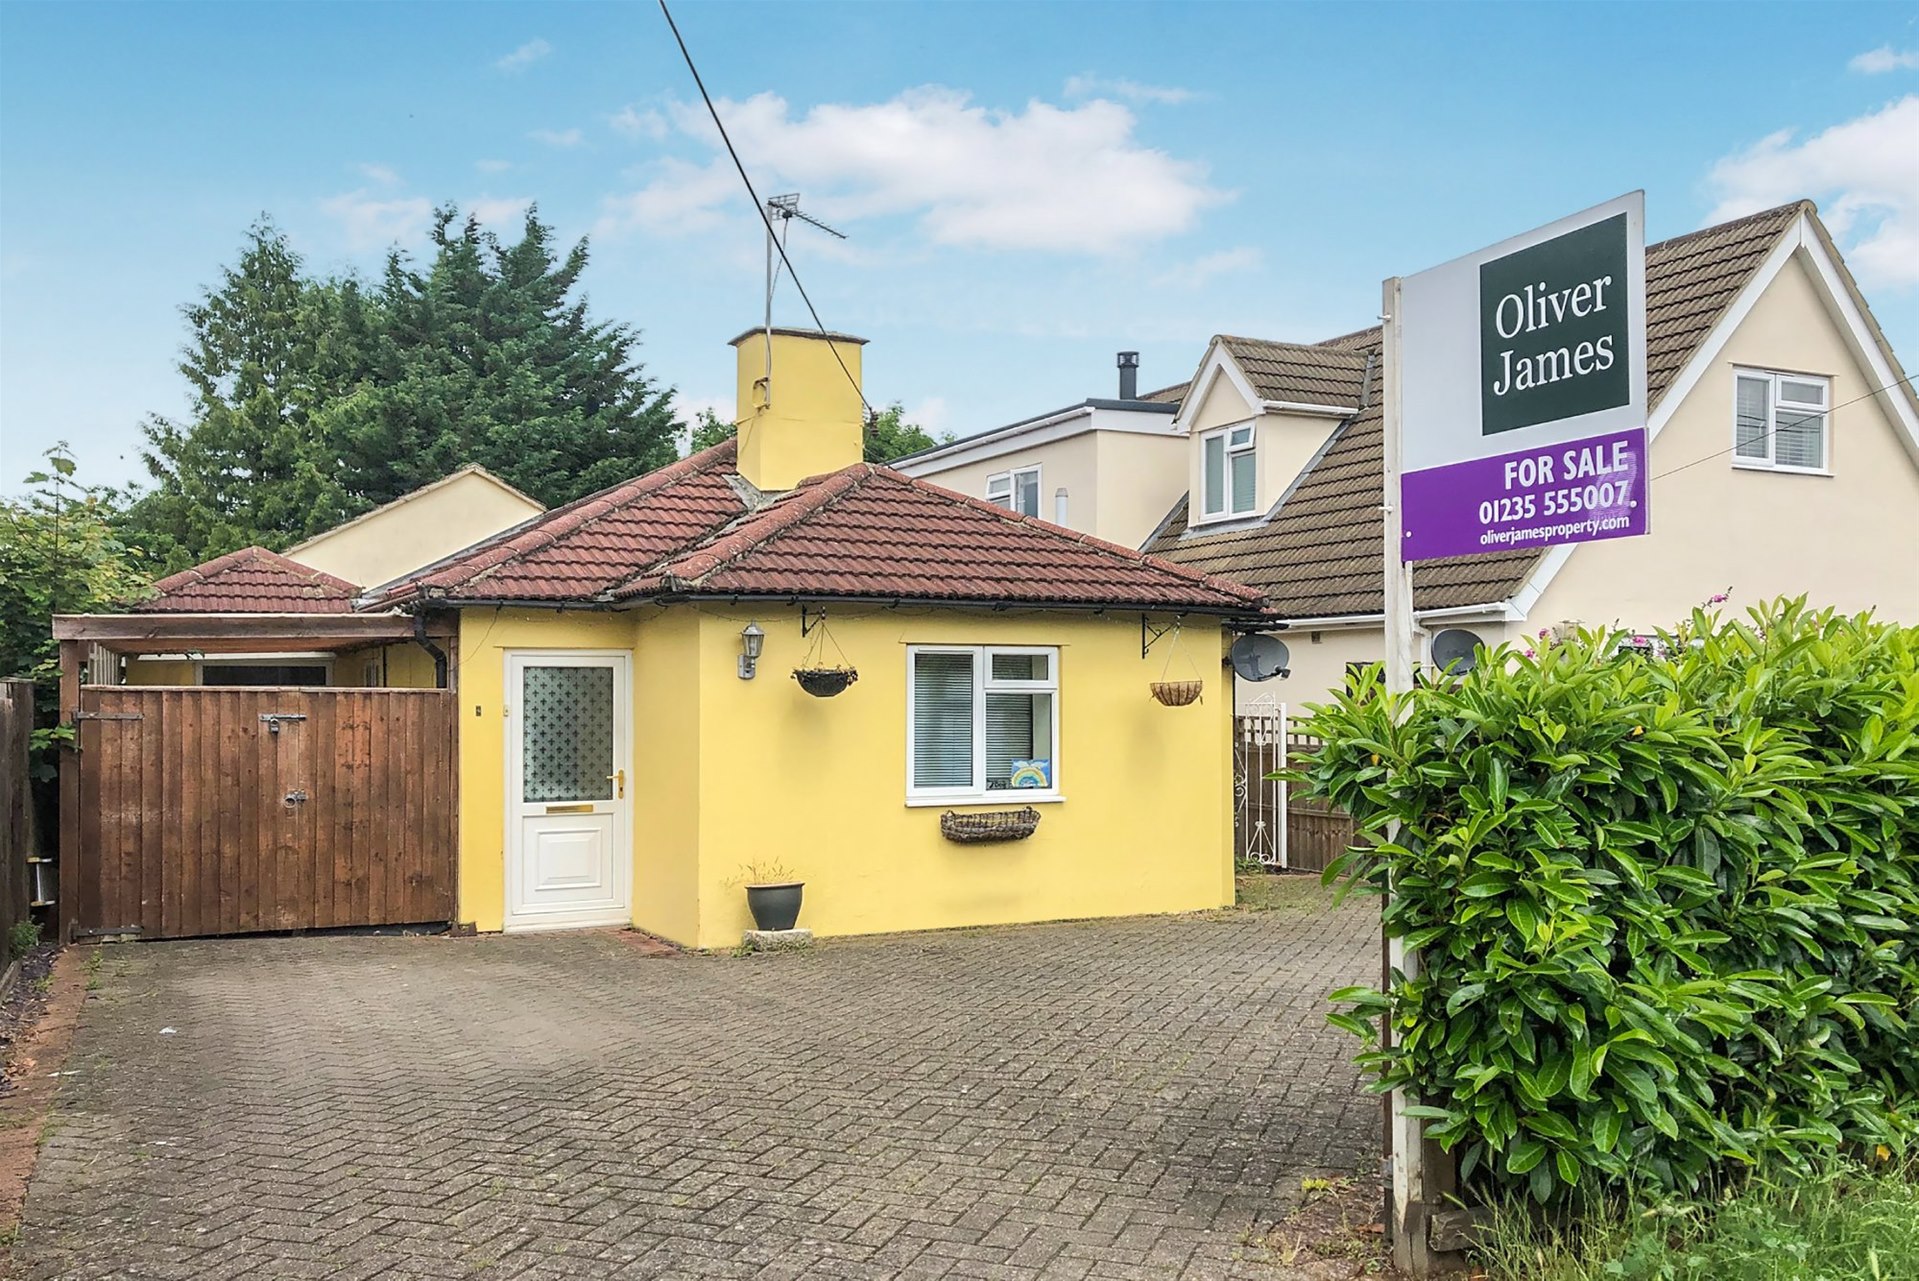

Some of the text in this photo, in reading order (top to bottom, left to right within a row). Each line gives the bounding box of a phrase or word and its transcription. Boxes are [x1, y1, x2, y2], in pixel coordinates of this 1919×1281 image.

[1496, 275, 1612, 339] Oliver
[1493, 335, 1615, 396] James
[1504, 440, 1629, 490] FOR SALE
[1479, 494, 1536, 525] 01235
[1480, 516, 1630, 546] oliverjamesproperty.com
